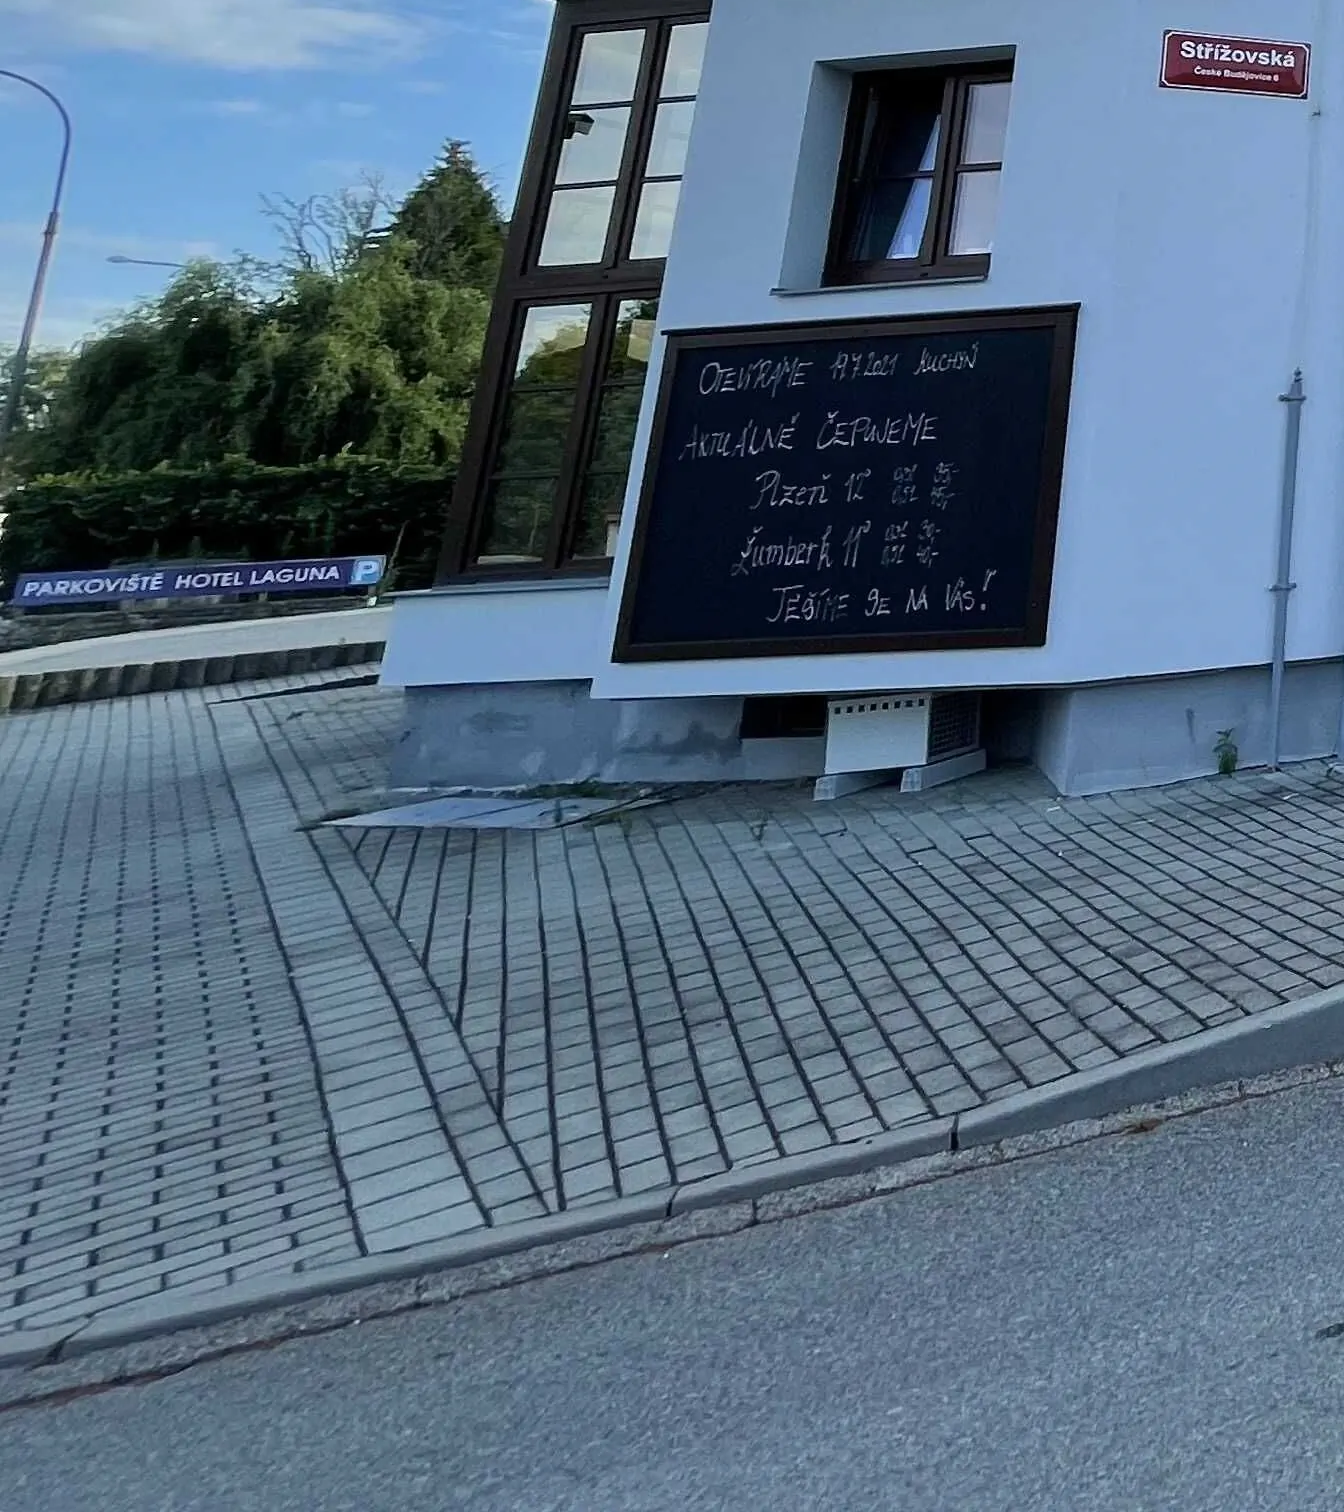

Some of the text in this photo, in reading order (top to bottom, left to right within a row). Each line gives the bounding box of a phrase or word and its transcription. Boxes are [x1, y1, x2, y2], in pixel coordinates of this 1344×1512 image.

[1180, 40, 1296, 68] Střížovská
[815, 410, 938, 451] ČEPUJEME
[749, 469, 832, 510] Plzeň
[22, 571, 164, 597] PARKOVIŠTĚ
[174, 569, 243, 591] HOTEL
[249, 565, 340, 586] LAGUNA
[905, 585, 929, 614] NA
